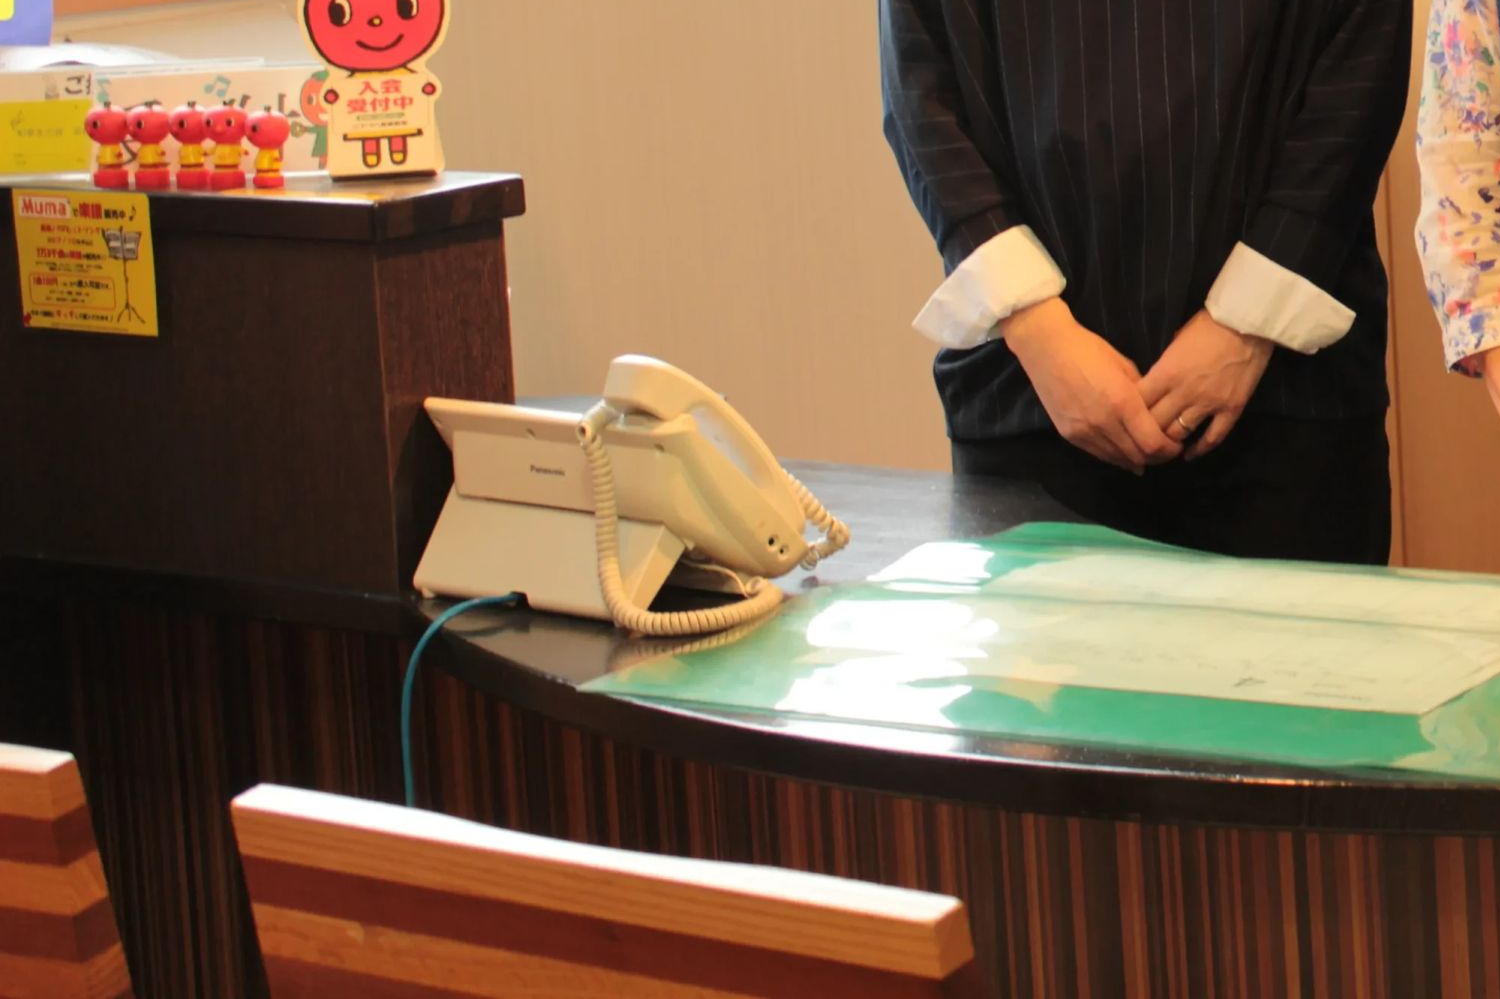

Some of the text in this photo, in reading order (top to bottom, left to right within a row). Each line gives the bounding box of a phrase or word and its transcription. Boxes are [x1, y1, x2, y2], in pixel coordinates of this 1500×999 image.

[358, 79, 402, 96] 入会
[346, 95, 414, 114] 受付中
[21, 198, 67, 217] Muma
[529, 463, 566, 477] Panasonic
